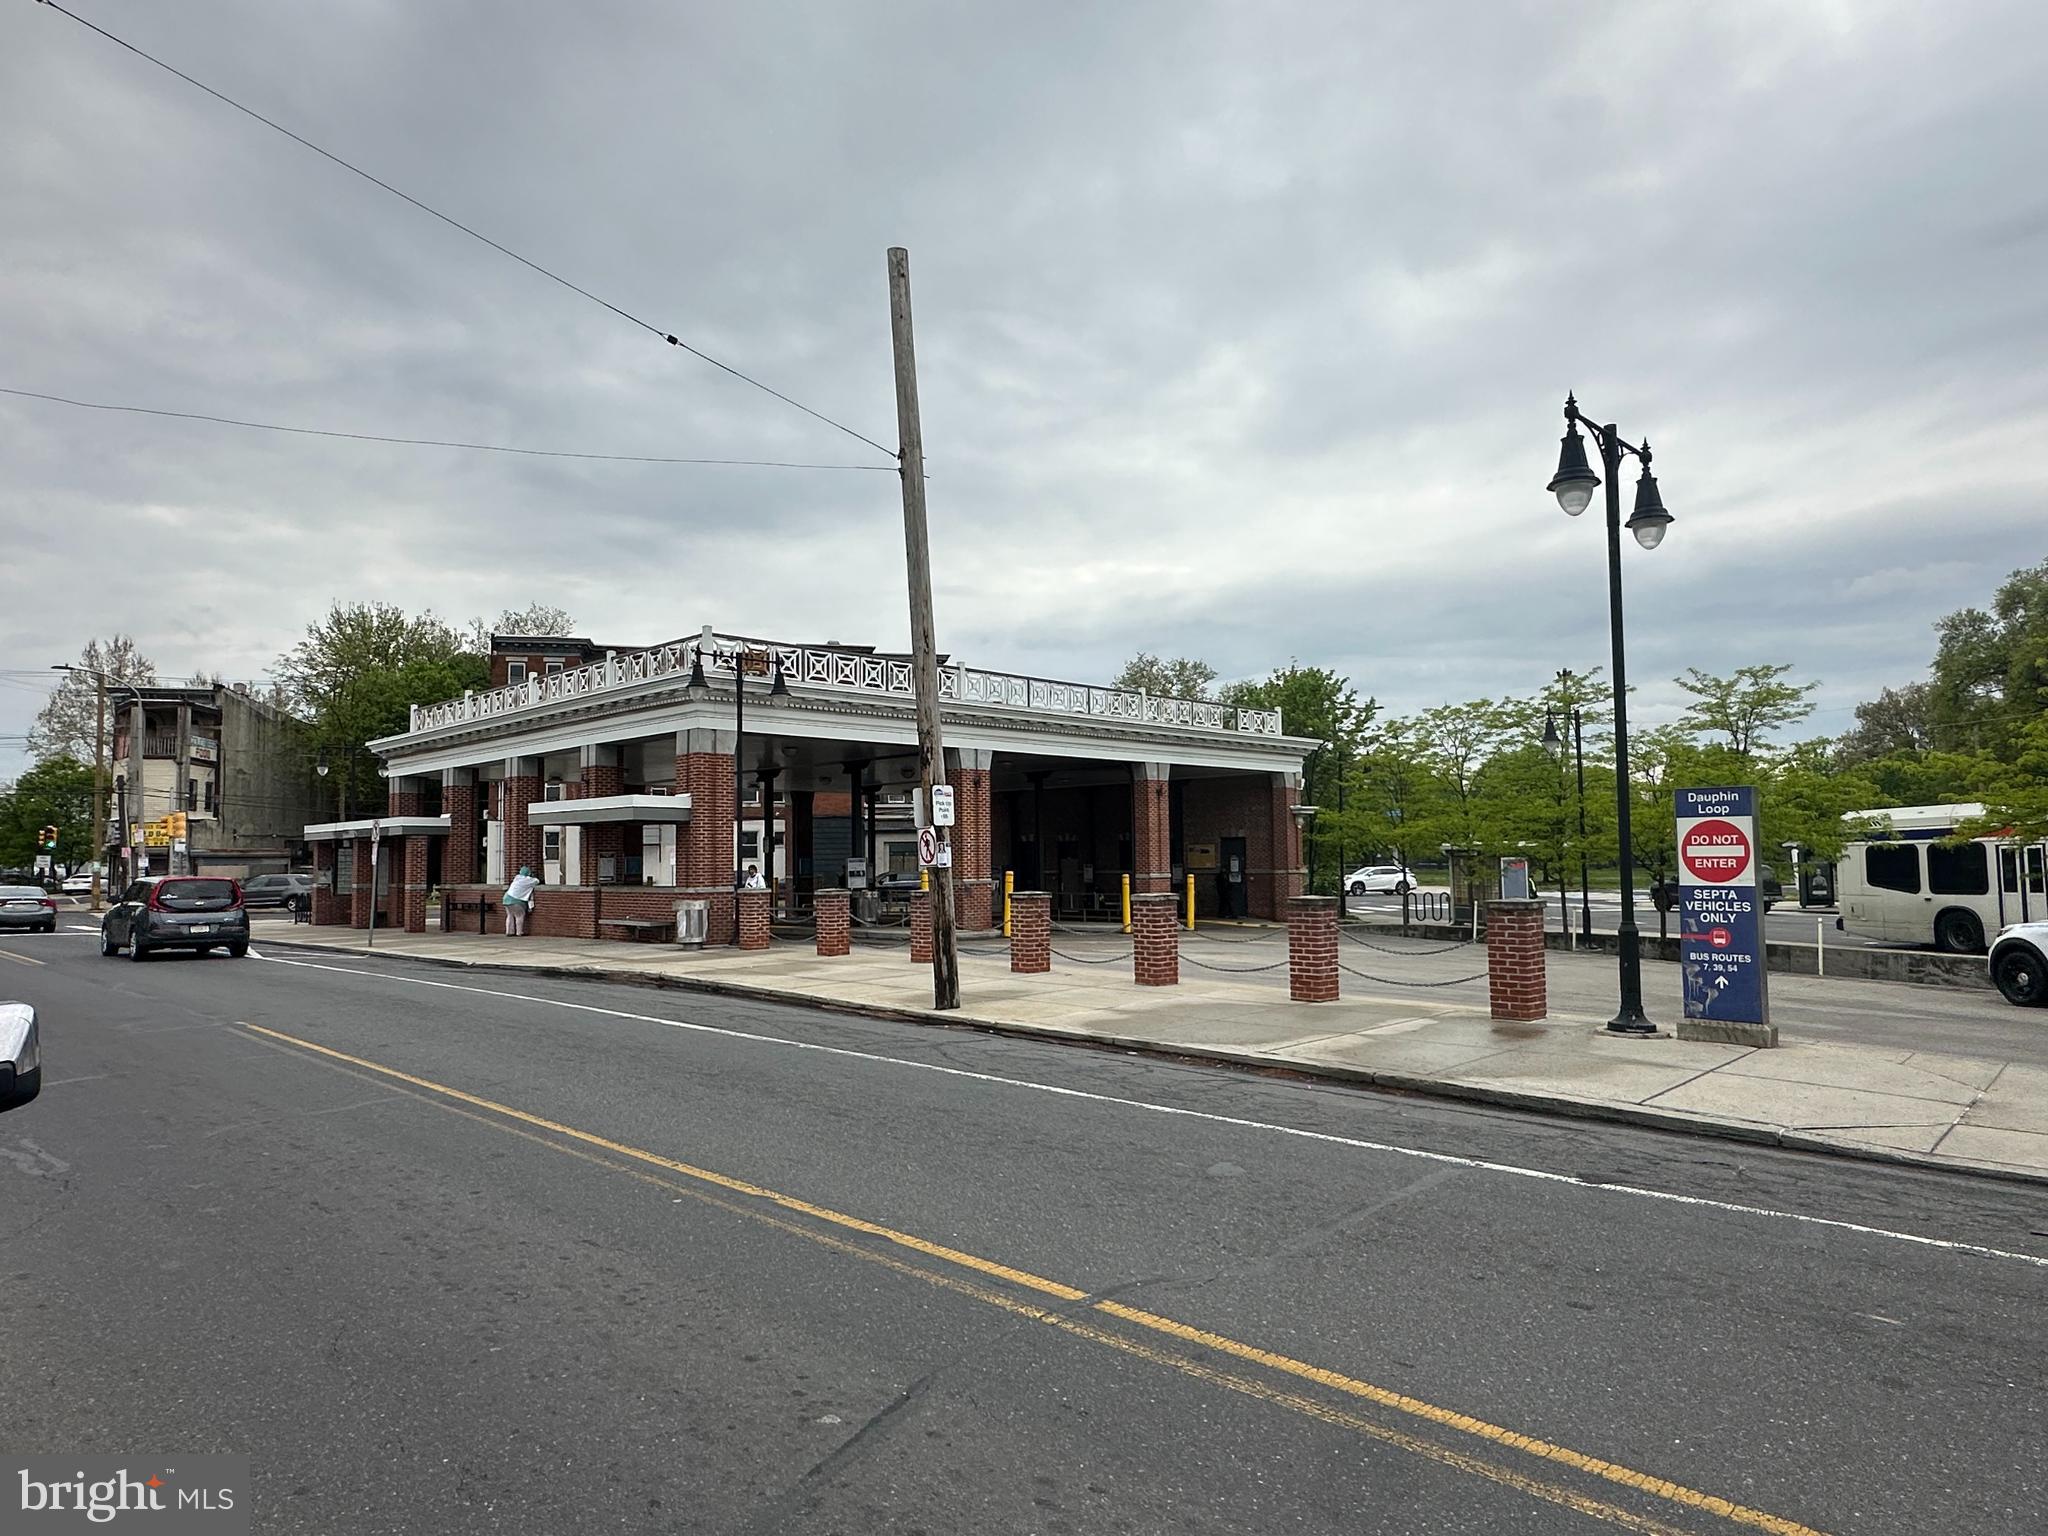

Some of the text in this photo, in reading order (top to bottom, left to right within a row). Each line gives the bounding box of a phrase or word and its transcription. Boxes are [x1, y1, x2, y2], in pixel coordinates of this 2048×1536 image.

[1687, 791, 1739, 804] Dauphin
[1698, 804, 1730, 816] Loop
[1691, 834, 1739, 845] DO NOT
[1694, 858, 1737, 868] ENTER
[1693, 889, 1738, 900] SEPTA
[1685, 901, 1751, 912] VEHICLES
[1699, 912, 1737, 923] ONLY
[1689, 952, 1752, 963] BUS ROUTES
[1703, 963, 1738, 972] 7, 39, 54
